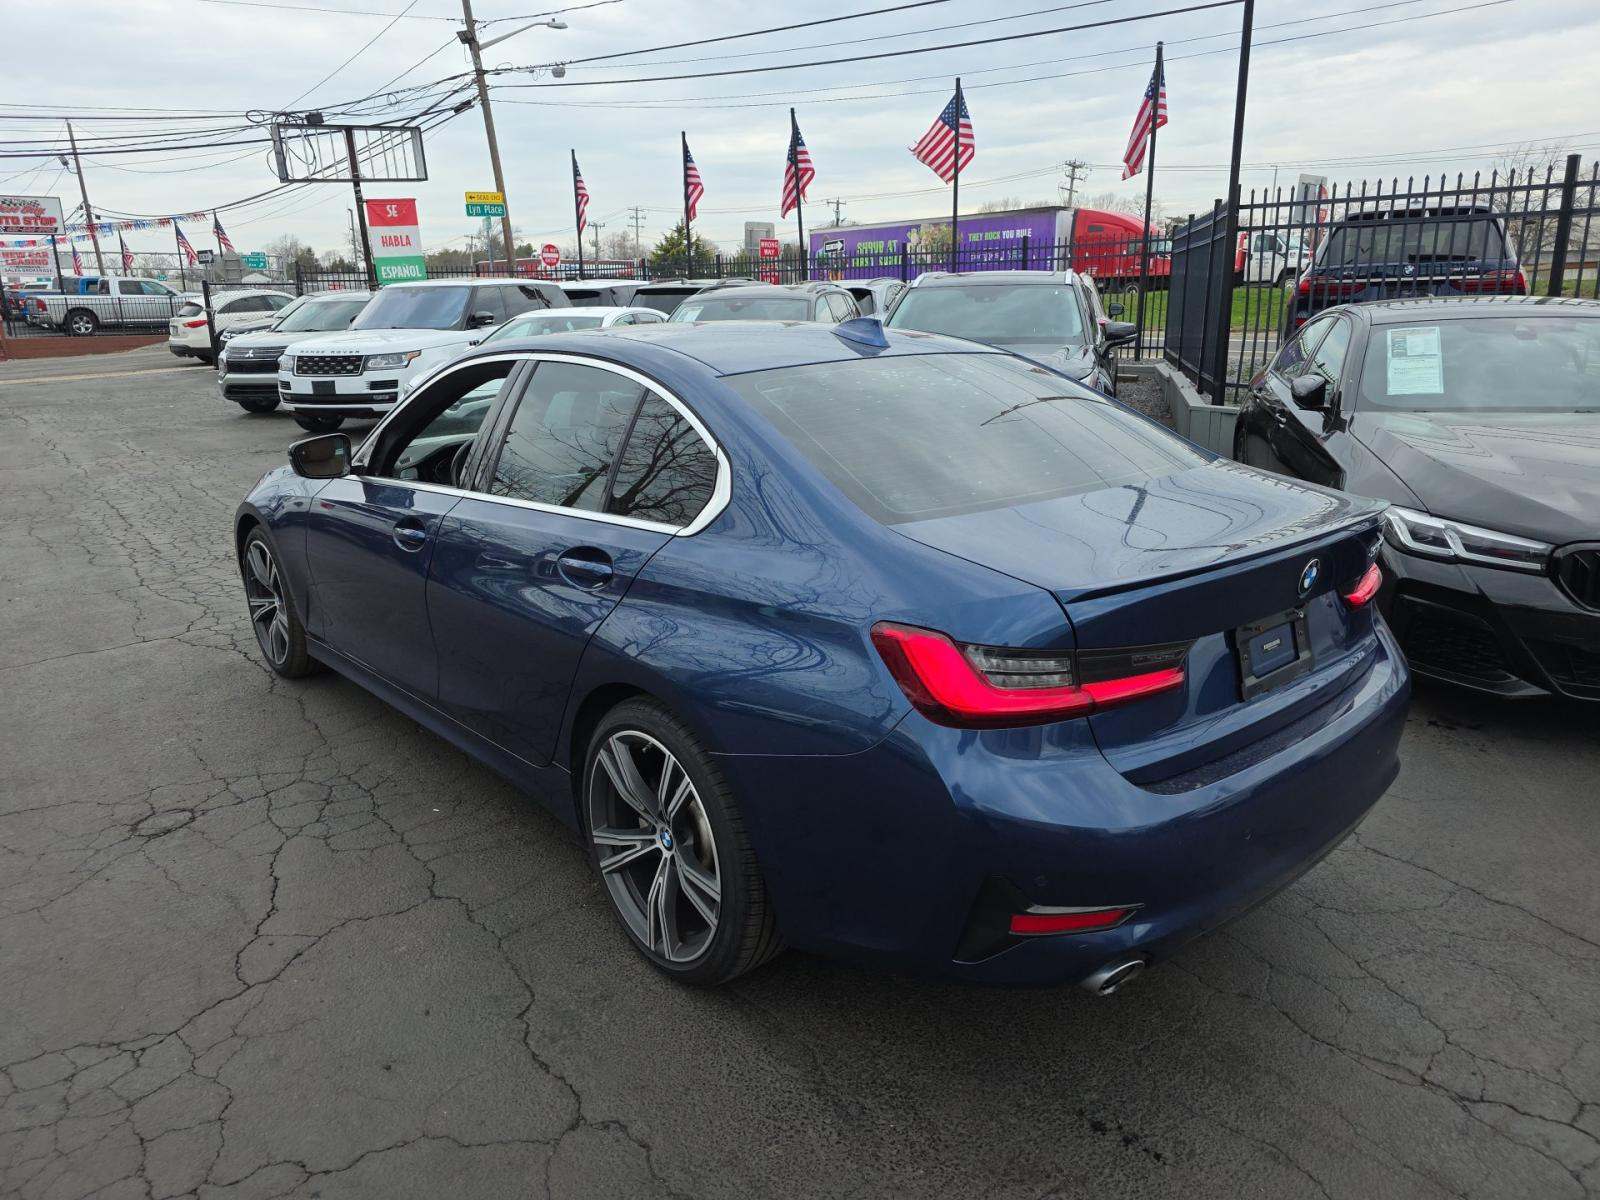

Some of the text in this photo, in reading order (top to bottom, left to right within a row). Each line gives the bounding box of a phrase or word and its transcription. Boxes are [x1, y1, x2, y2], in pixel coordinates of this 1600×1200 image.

[386, 204, 398, 218] SE
[469, 204, 503, 215] Lyn Place
[22, 216, 57, 226] STOP
[381, 234, 412, 248] HABLA
[968, 228, 1033, 242] THEY ROCK YOU RULE
[381, 264, 423, 279] ESPAÑOL
